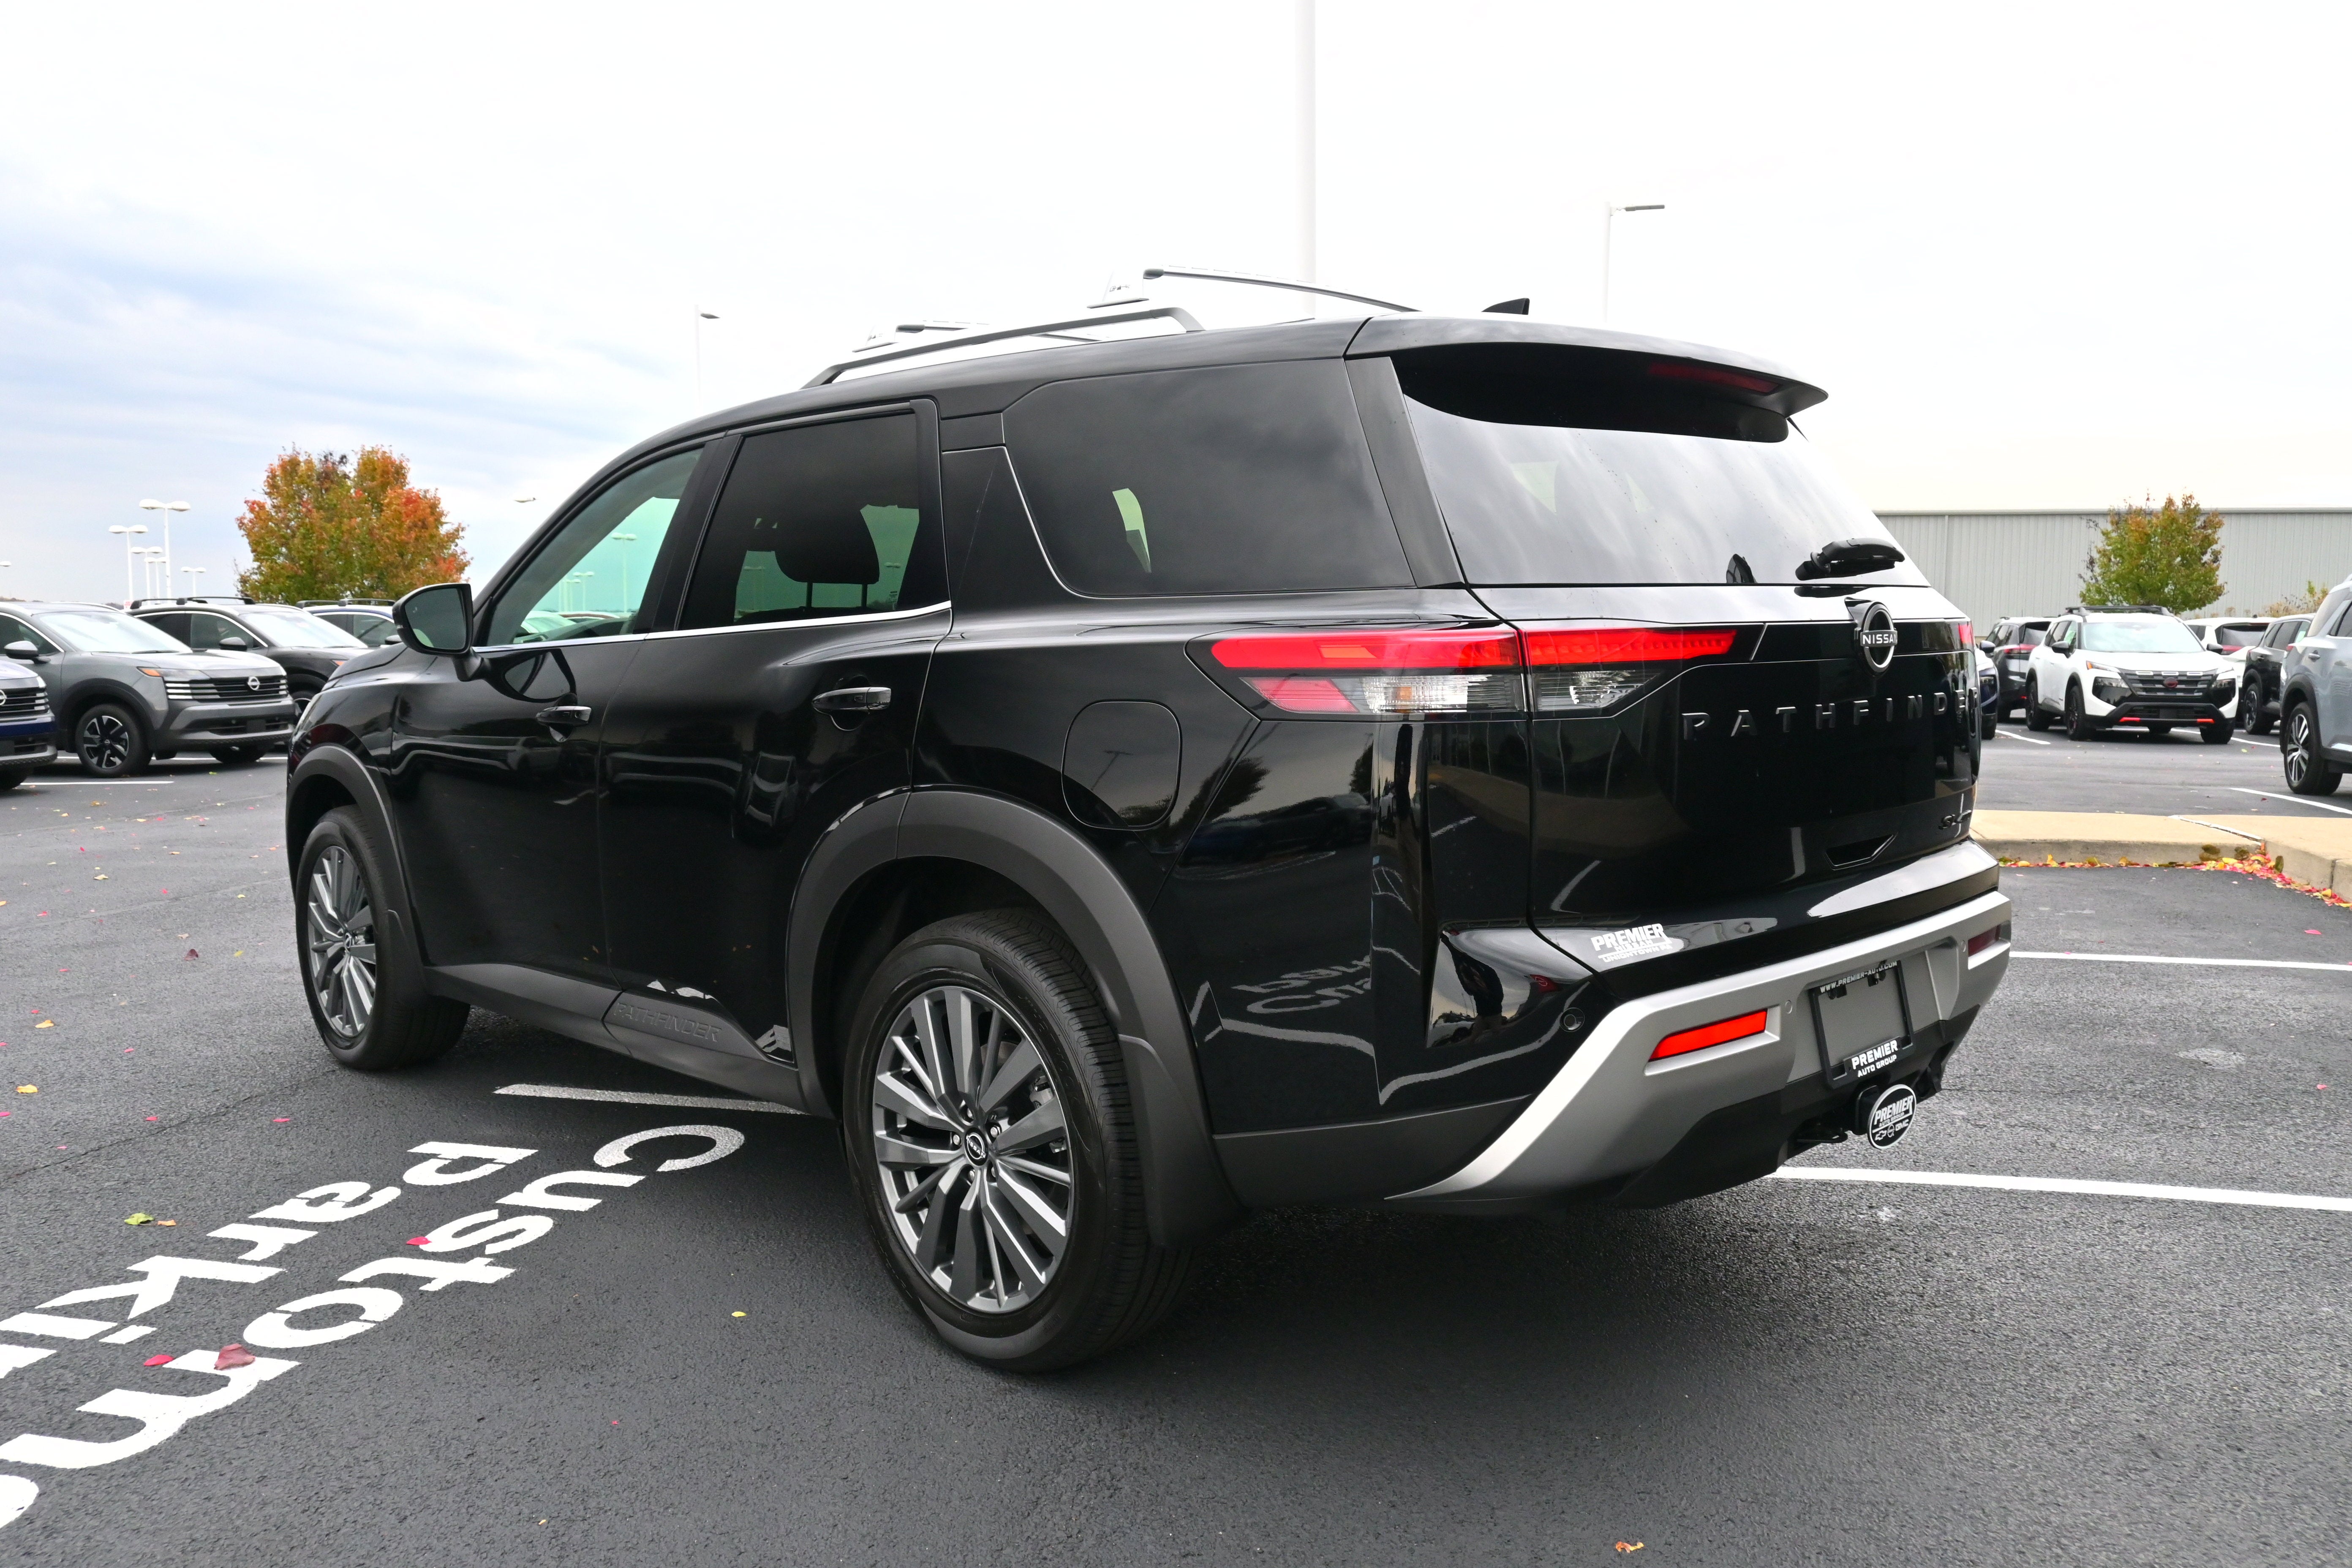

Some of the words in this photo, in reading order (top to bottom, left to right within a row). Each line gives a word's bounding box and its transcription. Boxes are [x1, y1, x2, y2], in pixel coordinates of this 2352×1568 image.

[1862, 634, 1897, 644] NISSAN
[1591, 923, 1665, 951] PREMIER
[1614, 939, 1653, 951] NISSAN
[1602, 945, 1660, 963] UNIONTOWN
[613, 1002, 722, 1042] PATHFINDER
[1851, 1040, 1898, 1070] PREMIER
[1857, 1064, 1876, 1078] AUTO
[1876, 1054, 1897, 1069] GROUP
[1874, 1095, 1913, 1125] PREMIER
[1879, 1119, 1890, 1127] AUTO
[1895, 1119, 1909, 1131] GMC
[0, 1124, 745, 1528] Custom
